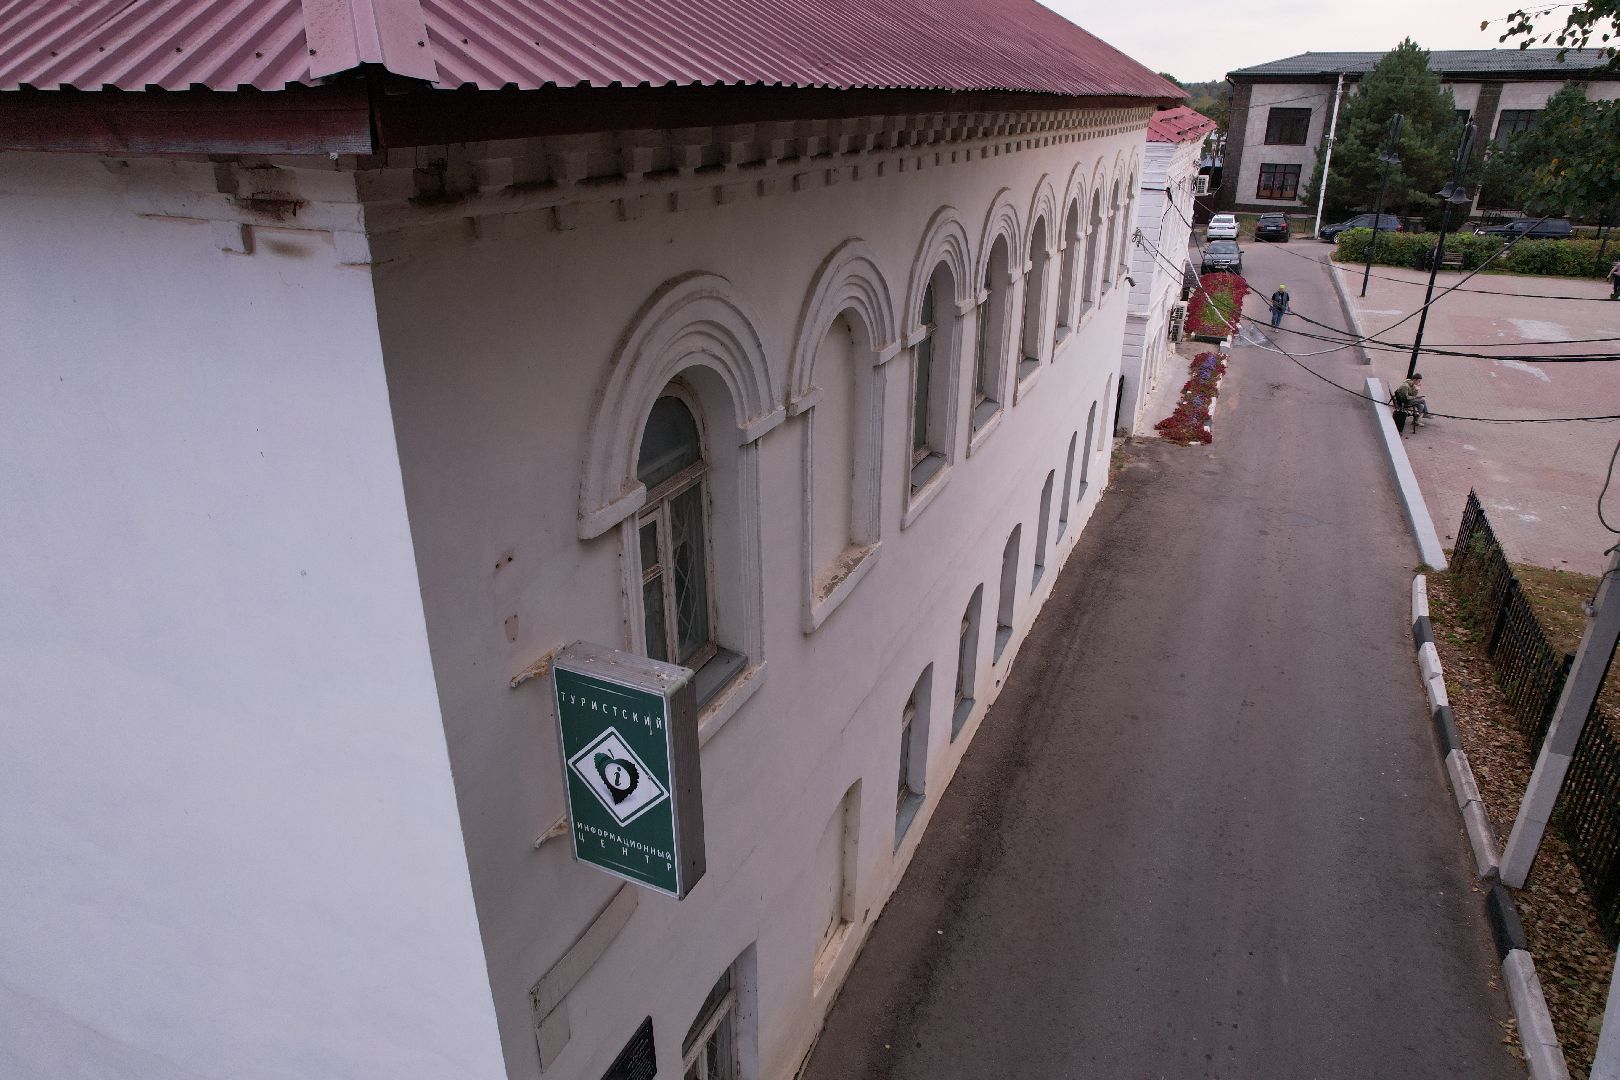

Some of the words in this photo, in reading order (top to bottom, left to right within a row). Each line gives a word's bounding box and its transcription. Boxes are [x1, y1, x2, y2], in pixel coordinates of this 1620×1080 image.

[560, 691, 662, 730] ТУРИСТСКИЙ
[577, 821, 672, 861] ИНФОРМАЦИОННЫЙ
[578, 831, 673, 872] ЦЕНТР
